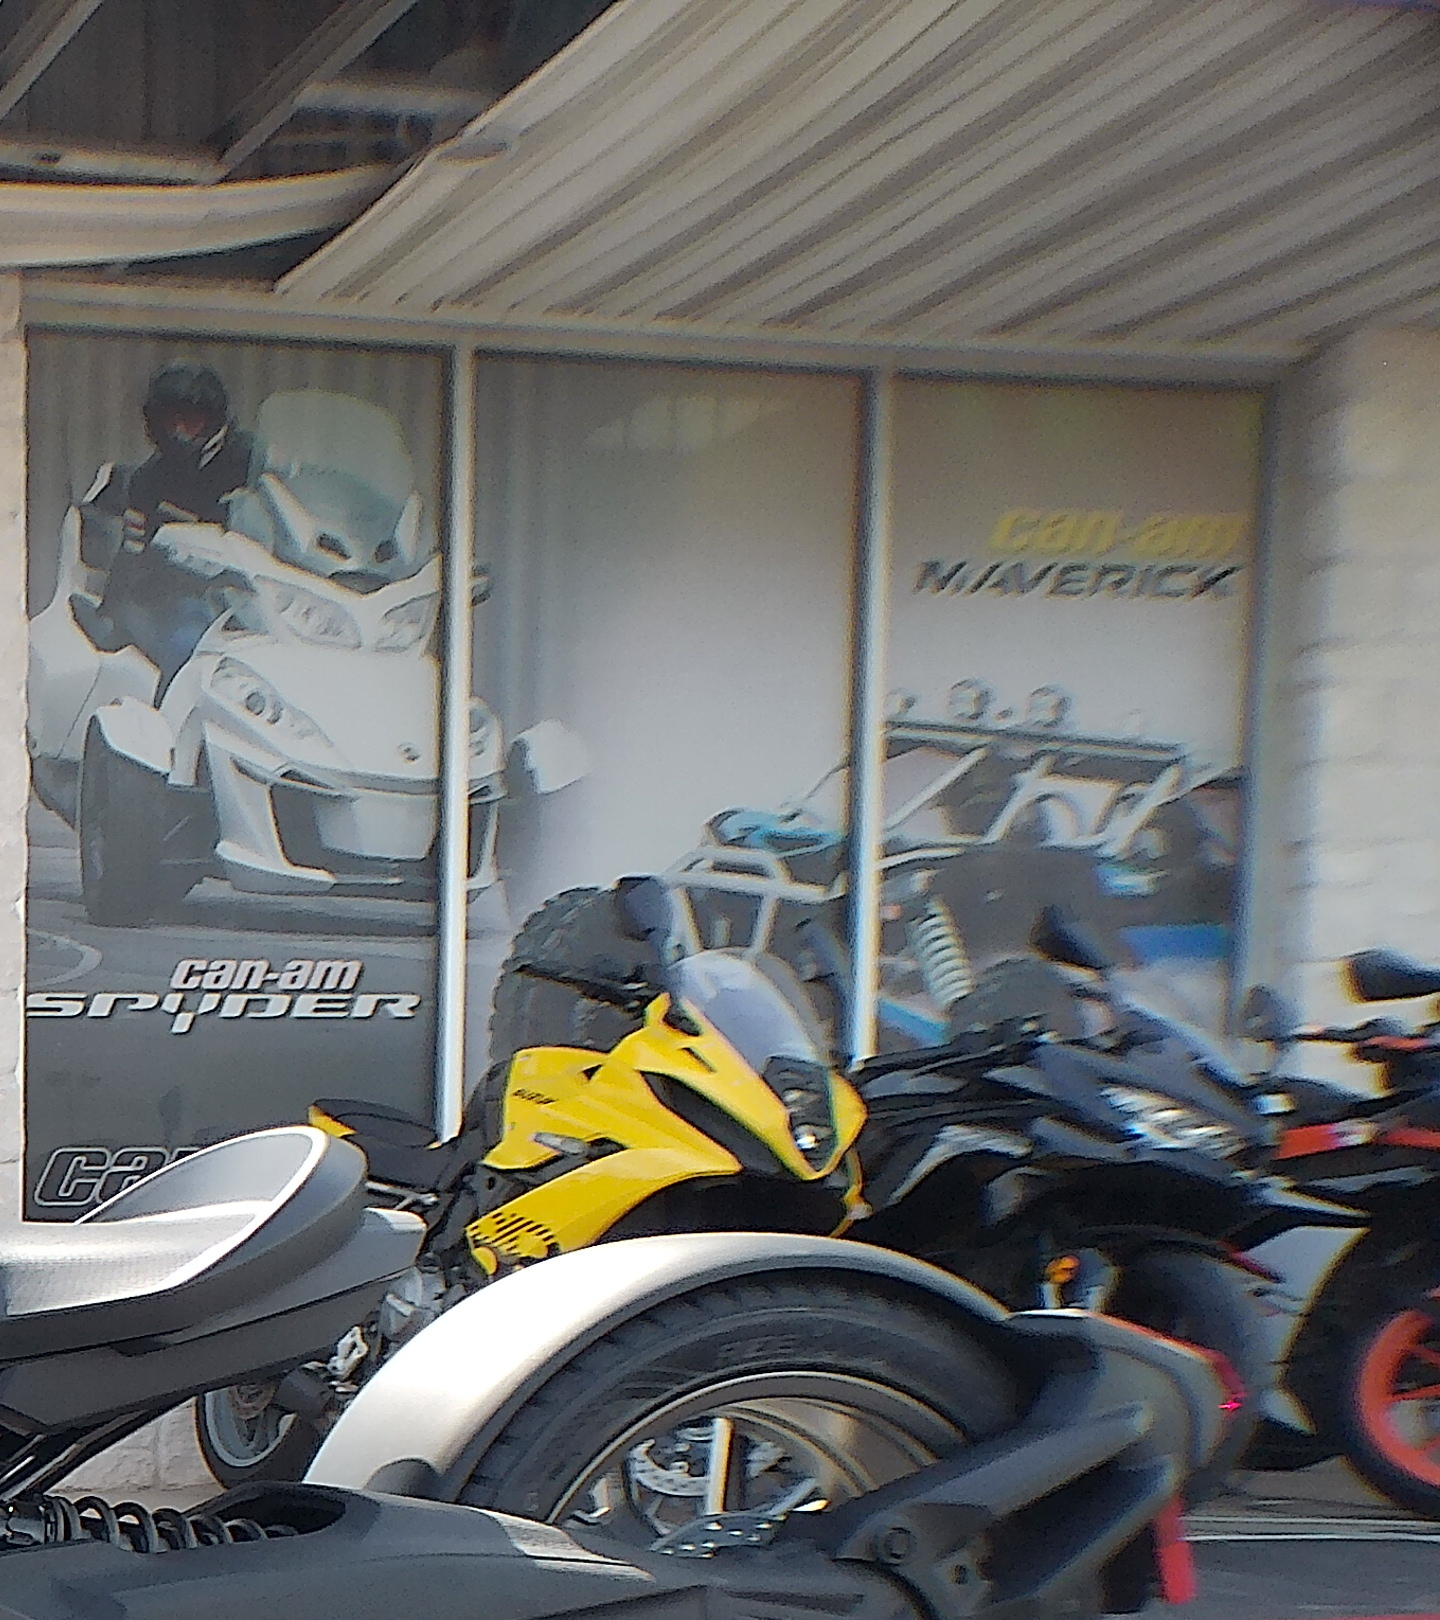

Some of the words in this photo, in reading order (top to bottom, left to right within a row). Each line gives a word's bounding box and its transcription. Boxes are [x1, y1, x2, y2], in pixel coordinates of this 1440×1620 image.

[914, 560, 1244, 601] MAVERICK
[169, 957, 365, 991] can-am
[25, 991, 421, 1035] SPYDER
